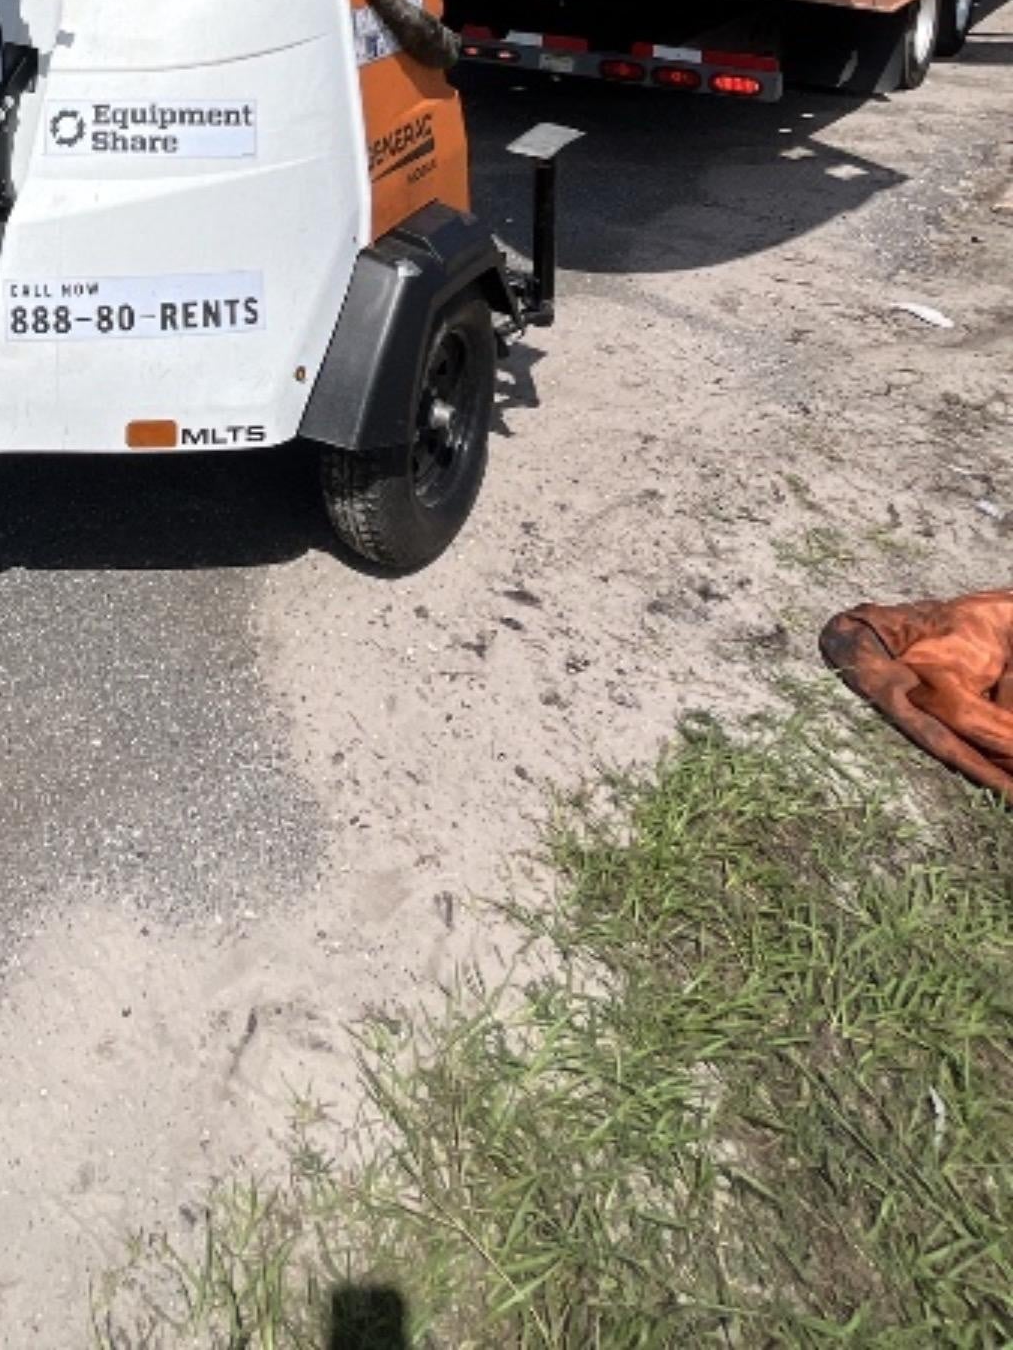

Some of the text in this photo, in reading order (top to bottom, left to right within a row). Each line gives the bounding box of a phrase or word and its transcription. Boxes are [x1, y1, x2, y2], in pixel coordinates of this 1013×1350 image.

[91, 103, 253, 130] Equipment
[91, 131, 179, 153] Share
[10, 282, 100, 298] CALL NOW
[10, 297, 259, 334] 888-80-RENTS
[181, 425, 266, 445] MLTS
